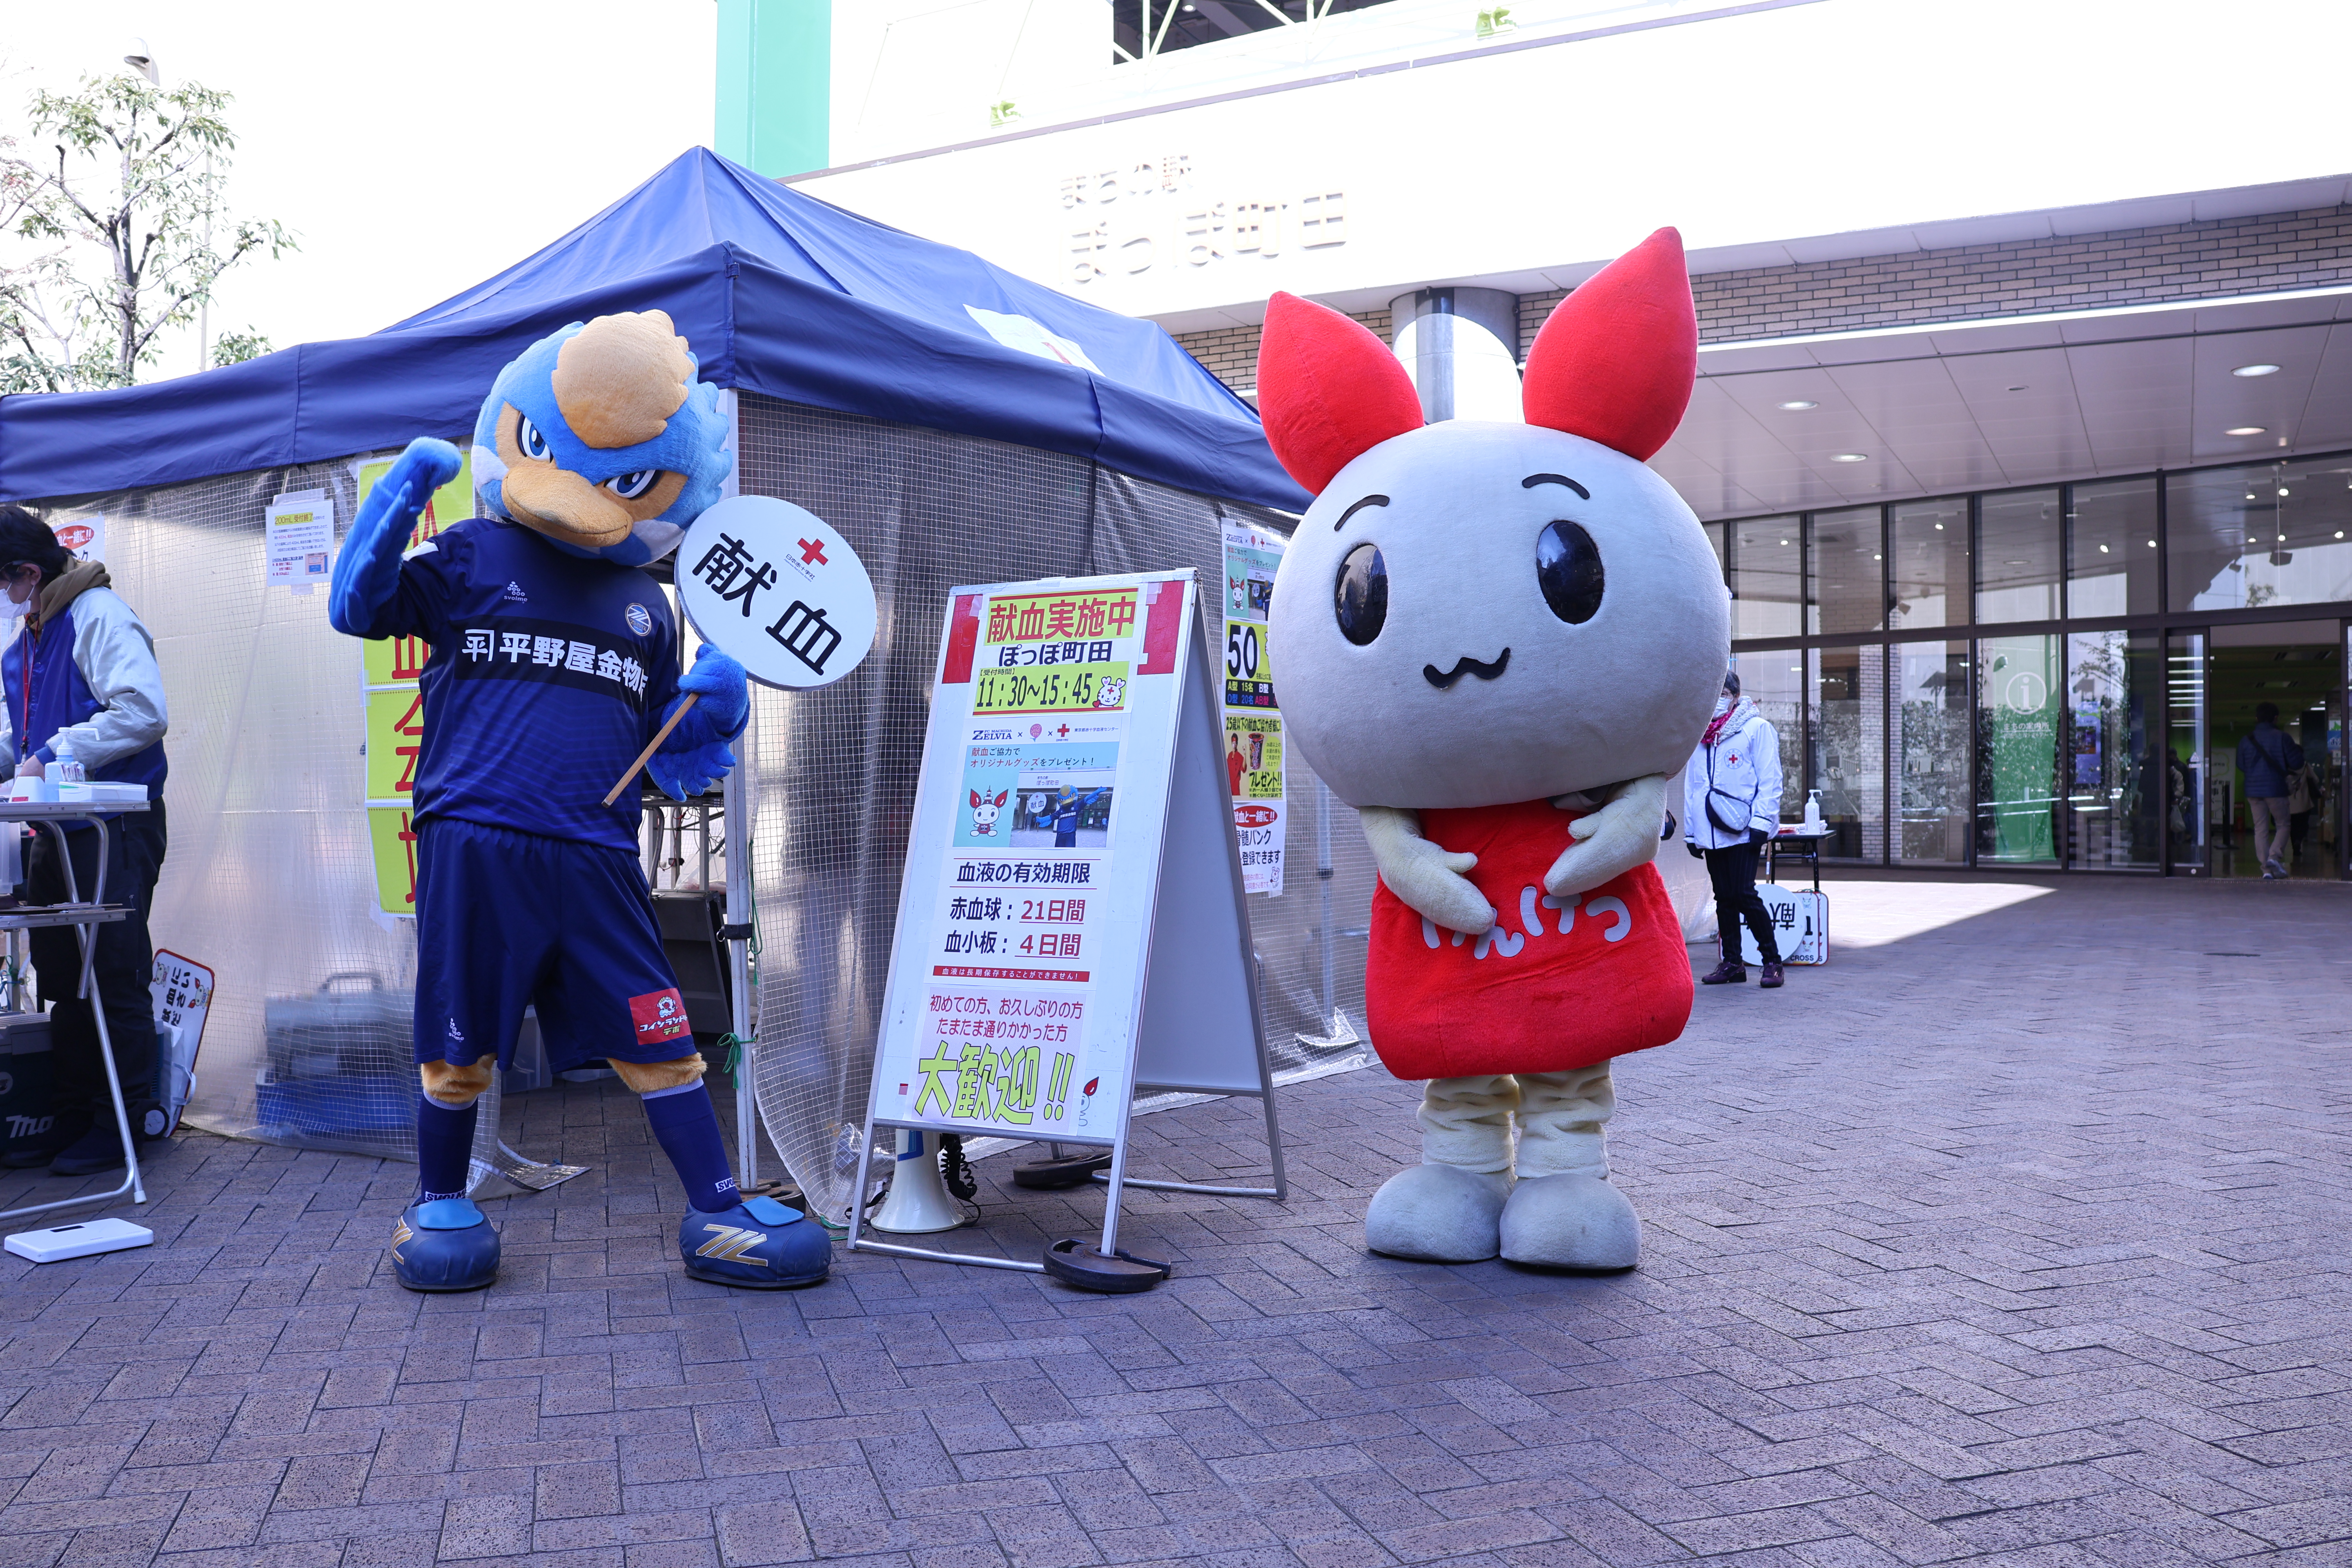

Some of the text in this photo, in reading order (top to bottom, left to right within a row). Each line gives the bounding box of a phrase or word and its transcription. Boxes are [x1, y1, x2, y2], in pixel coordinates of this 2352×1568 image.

[275, 516, 292, 524] 200mL
[294, 513, 313, 522] 受付終了
[1226, 534, 1243, 544] ZELVIA
[1227, 546, 1247, 555] 献血ご協力で
[784, 559, 794, 567] Japanese
[786, 554, 815, 580] 日本赤十字社
[692, 532, 842, 676] 献血
[987, 595, 1136, 643] 献血実施中
[999, 641, 1112, 667] ぽっぽ町田
[1228, 624, 1258, 678] 50
[1228, 681, 1238, 691] A型
[1241, 682, 1253, 692] 15名
[1259, 683, 1269, 693] B型
[1227, 693, 1238, 704] O型
[1241, 695, 1253, 704] 20名
[1255, 696, 1269, 705] AB型
[972, 730, 1013, 740] ZELVIA
[971, 747, 1020, 757] 献血ご協力で
[970, 757, 1094, 768] オリジナルグッズをプレゼント！
[1249, 771, 1282, 787] プレゼント!!
[1030, 800, 1044, 809] 献血
[1241, 849, 1281, 866] 登録できます
[957, 861, 1091, 884] 血液の有効期限
[1244, 881, 1269, 889] の同意が必要です
[942, 967, 1078, 980] 血液は長期保存することができません！
[663, 1025, 681, 1036] デポ
[936, 1018, 1068, 1042] たまたま通りかかった方
[717, 1178, 735, 1191] SVO
